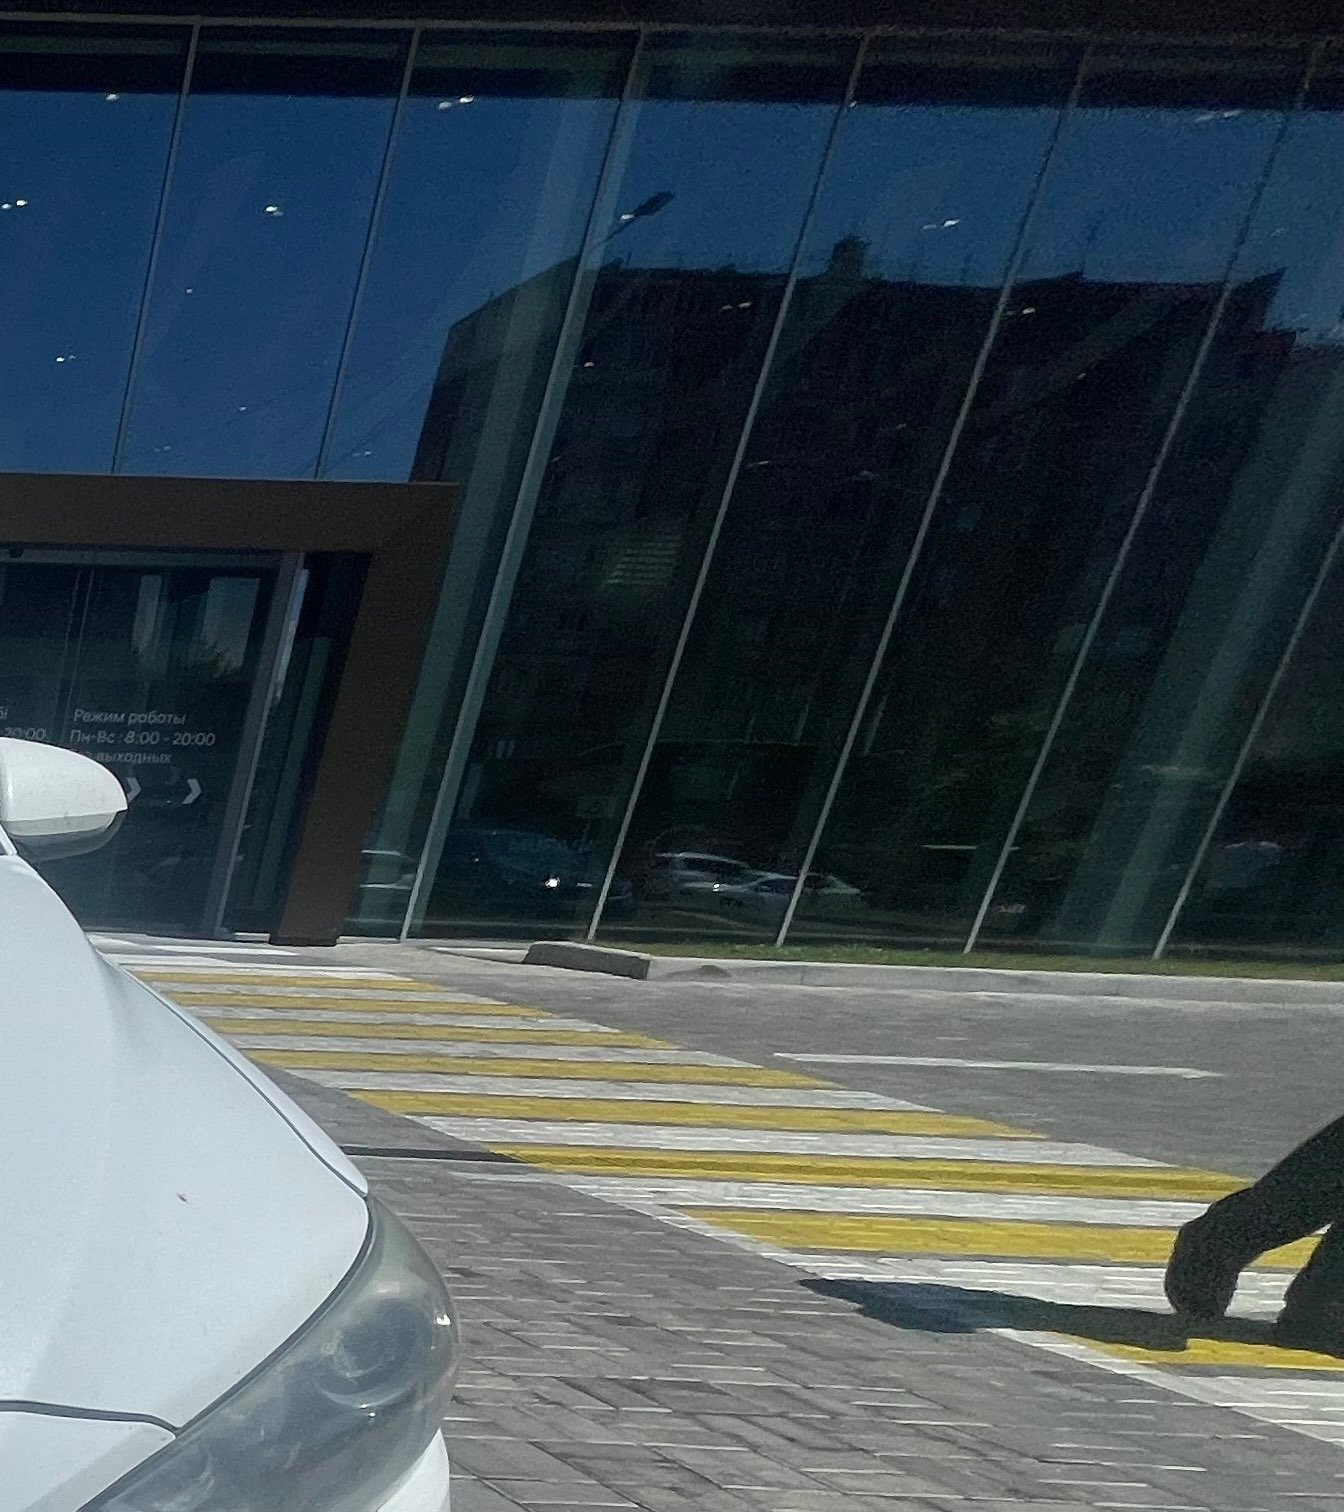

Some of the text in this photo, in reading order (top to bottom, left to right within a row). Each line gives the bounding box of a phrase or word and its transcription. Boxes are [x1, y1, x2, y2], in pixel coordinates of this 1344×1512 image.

[73, 708, 187, 726] Режим работы
[172, 732, 217, 746] 20:00
